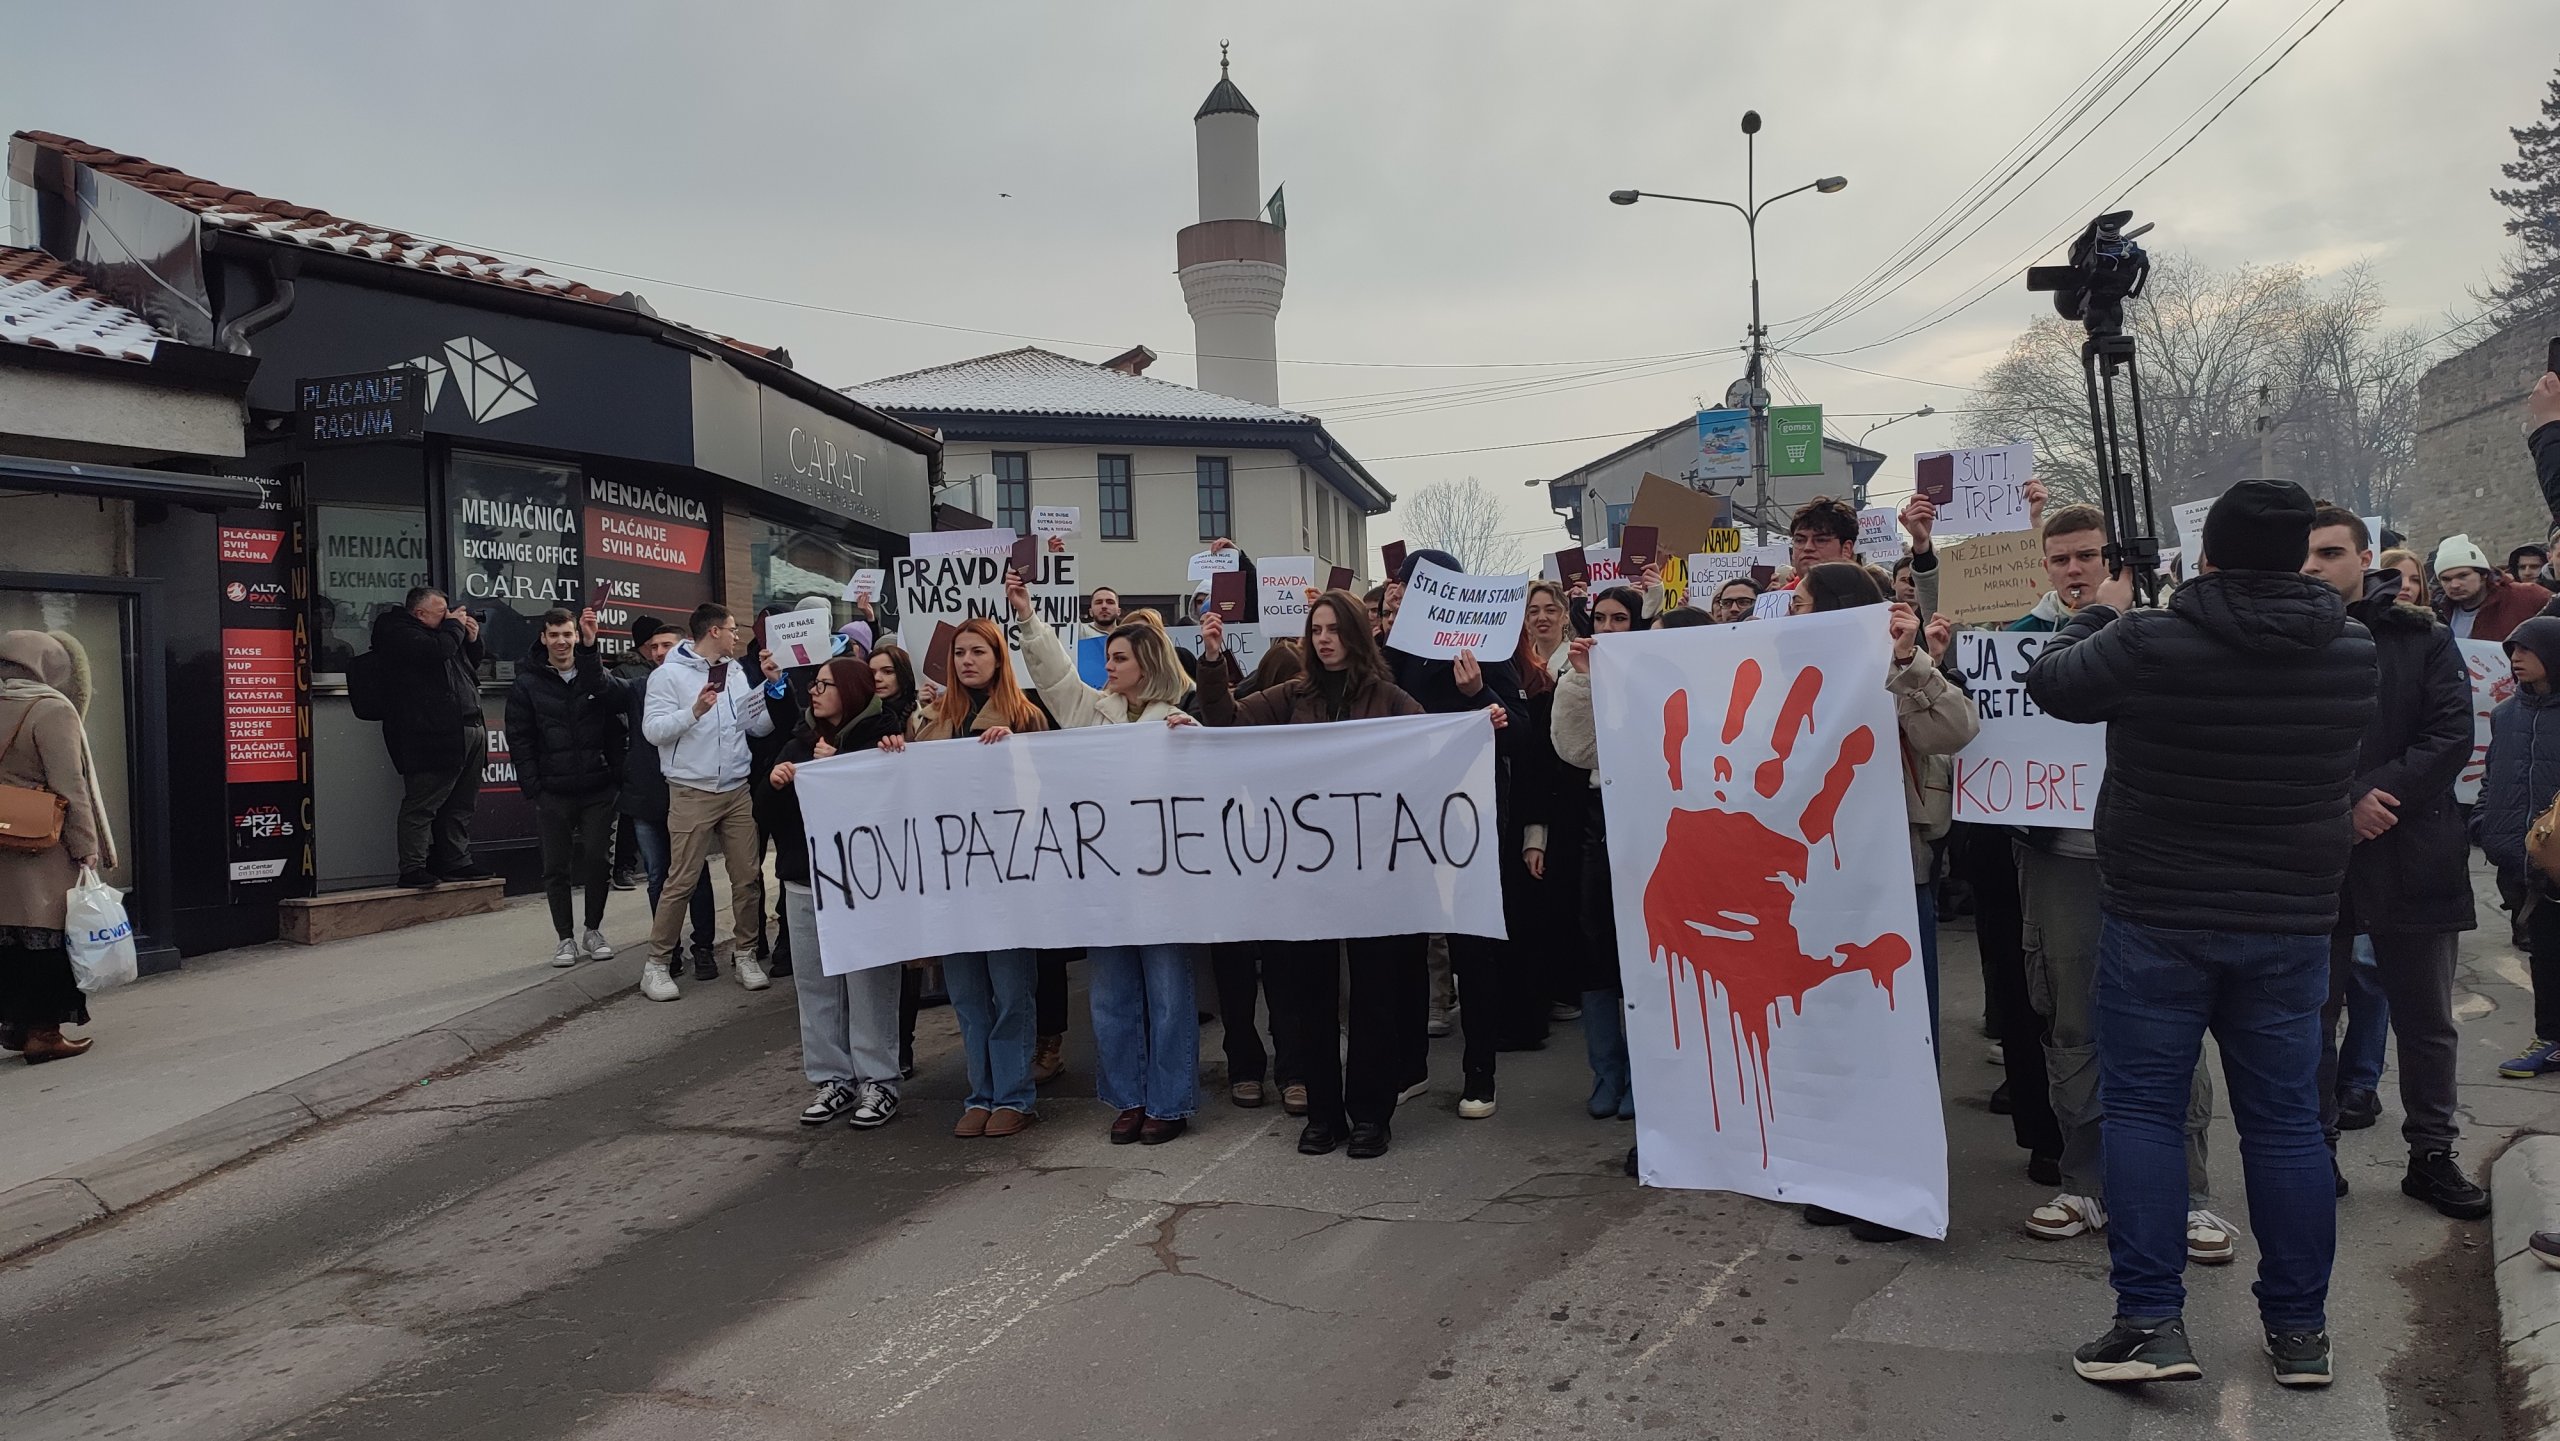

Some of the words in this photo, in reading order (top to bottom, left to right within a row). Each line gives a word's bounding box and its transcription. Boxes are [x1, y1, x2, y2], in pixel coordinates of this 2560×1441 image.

[314, 409, 393, 440] RACUNA
[1782, 423, 1812, 434] gomex
[789, 427, 866, 497] CARAT
[1960, 452, 2015, 482] ŠUTI,
[590, 477, 708, 523] MENJAČNICA
[462, 496, 577, 534] MENJAČNICA
[223, 530, 278, 542] PLAĆANJE
[601, 516, 667, 543] PLAĆANJE
[223, 541, 249, 549] SVIH
[328, 529, 427, 559] MENJAČN
[1951, 548, 1966, 562] NE
[1970, 543, 2012, 560] ŽELIM
[2020, 539, 2037, 551] DA
[223, 550, 268, 560] RAČUNA
[463, 539, 532, 563] EXCHANGE
[536, 545, 578, 566] OFFICE
[602, 538, 632, 557] SVIH
[636, 543, 687, 565] RAČUNA
[1710, 555, 1760, 568] POSLEDICA
[1035, 555, 1075, 585] JE
[1691, 568, 1715, 583] LOŠE
[1716, 570, 1752, 583] STATIK
[1964, 563, 2003, 579] PLAŠIM
[329, 571, 406, 588] EXCHANGE
[1262, 575, 1308, 587] PRAVDA
[250, 583, 286, 593] ALTA
[466, 573, 579, 602] CARAT
[1413, 571, 1438, 596] ŠTA
[1440, 581, 1459, 601] ĆE
[1458, 588, 1489, 604] NAM
[250, 594, 277, 603] PAY
[908, 583, 962, 614] NAŠ
[1277, 590, 1294, 601] ZA
[1263, 605, 1309, 616] KOLEGE
[1428, 604, 1456, 625] KAD
[1455, 610, 1508, 626] NEMAMO
[597, 610, 628, 626] MUP
[787, 621, 796, 630] JE
[796, 617, 815, 627] NAŠE
[781, 630, 808, 641] ORUŽJE
[1433, 631, 1481, 647] DRŽAVU
[227, 647, 262, 656] TAKSE
[228, 662, 252, 670] MUP
[229, 677, 277, 685] TELEFON
[228, 692, 283, 700] KATASTAR
[229, 706, 292, 714] KOMUNALIJE
[230, 720, 272, 729] SUDSKE
[230, 729, 264, 737] TAKSE
[230, 742, 285, 751] PLAĆANJE
[230, 751, 293, 760] KARTICAMA
[1957, 757, 2013, 814] KO
[2026, 760, 2088, 812] BRE
[246, 806, 280, 814] ALTA
[808, 816, 925, 910] NOVI
[935, 800, 1121, 890] PAZAR
[1130, 796, 1212, 877] JE
[1220, 791, 1481, 880] (U)STAO
[89, 929, 111, 941] LC
